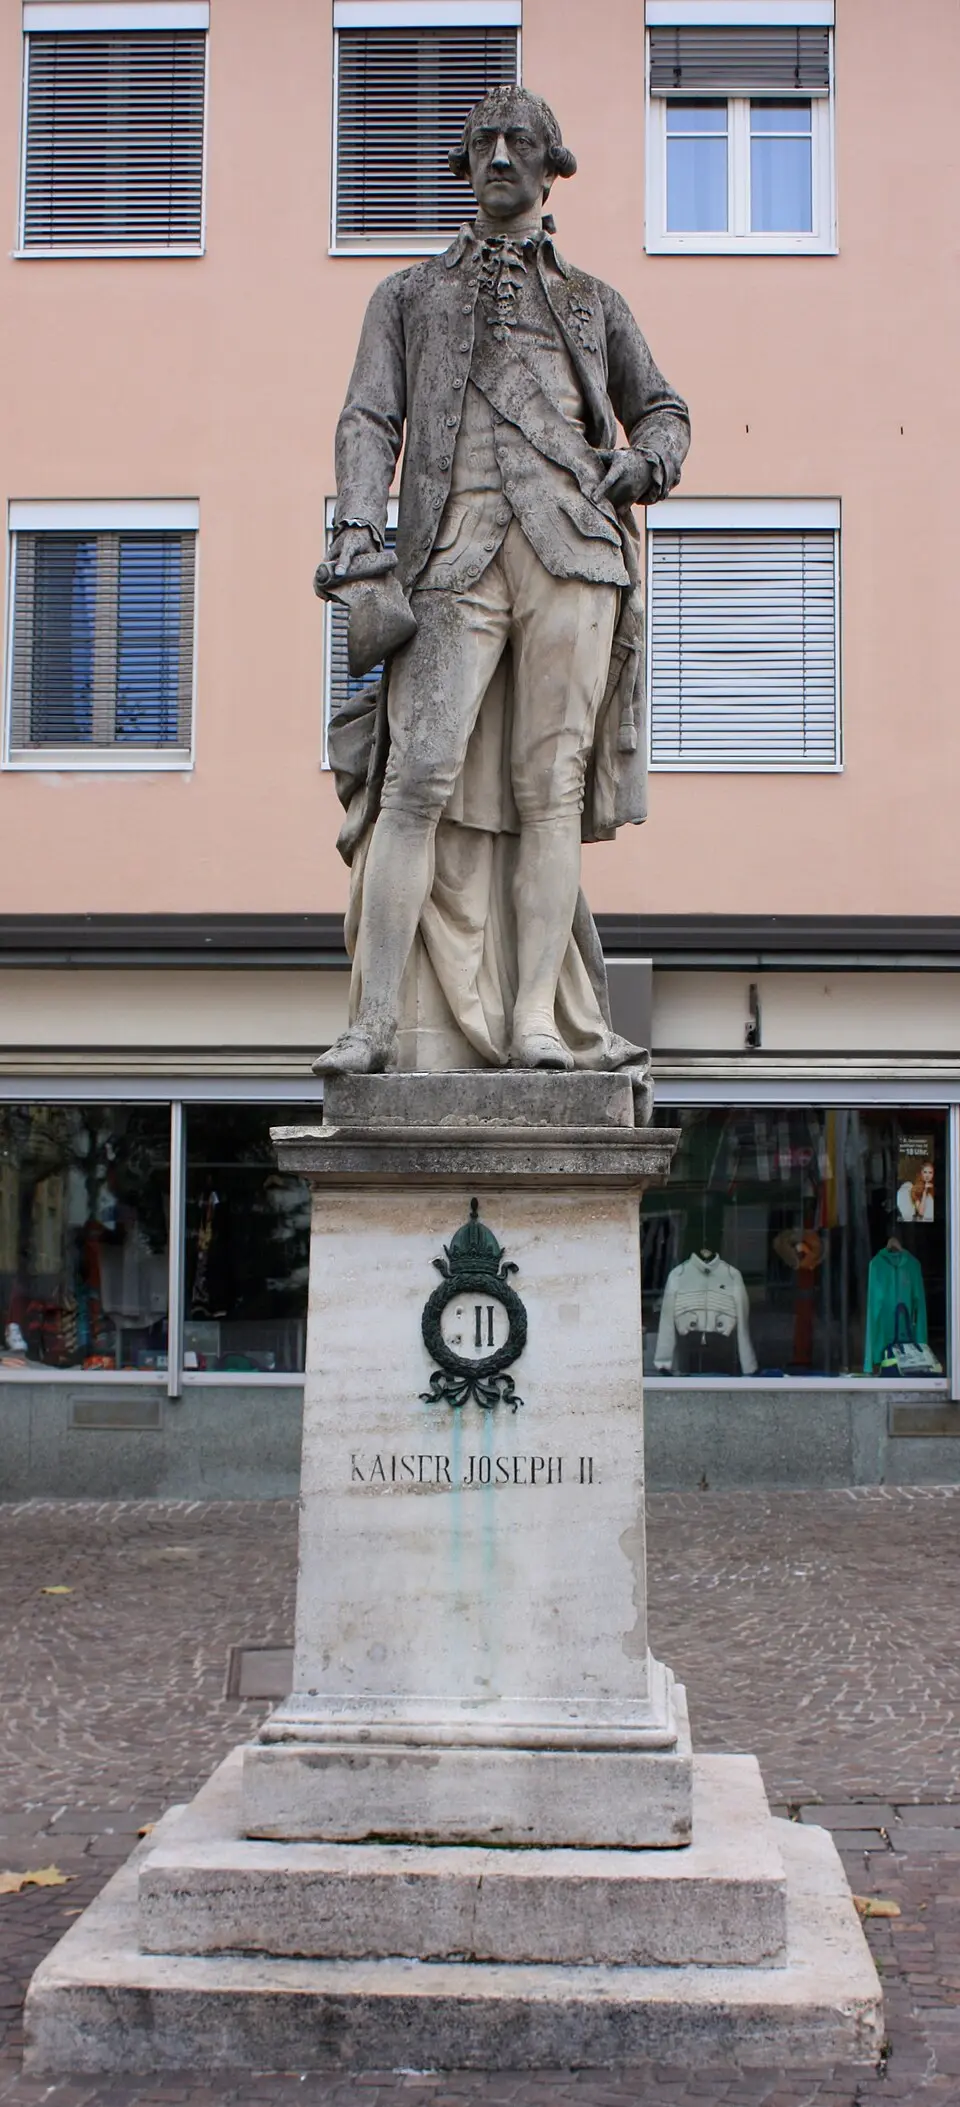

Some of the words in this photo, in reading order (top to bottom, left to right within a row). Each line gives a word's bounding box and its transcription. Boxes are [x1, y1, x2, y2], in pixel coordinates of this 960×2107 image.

[350, 1454, 453, 1484] KAISER
[463, 1455, 563, 1485] JOSEPH
[578, 1456, 602, 1485] II.
